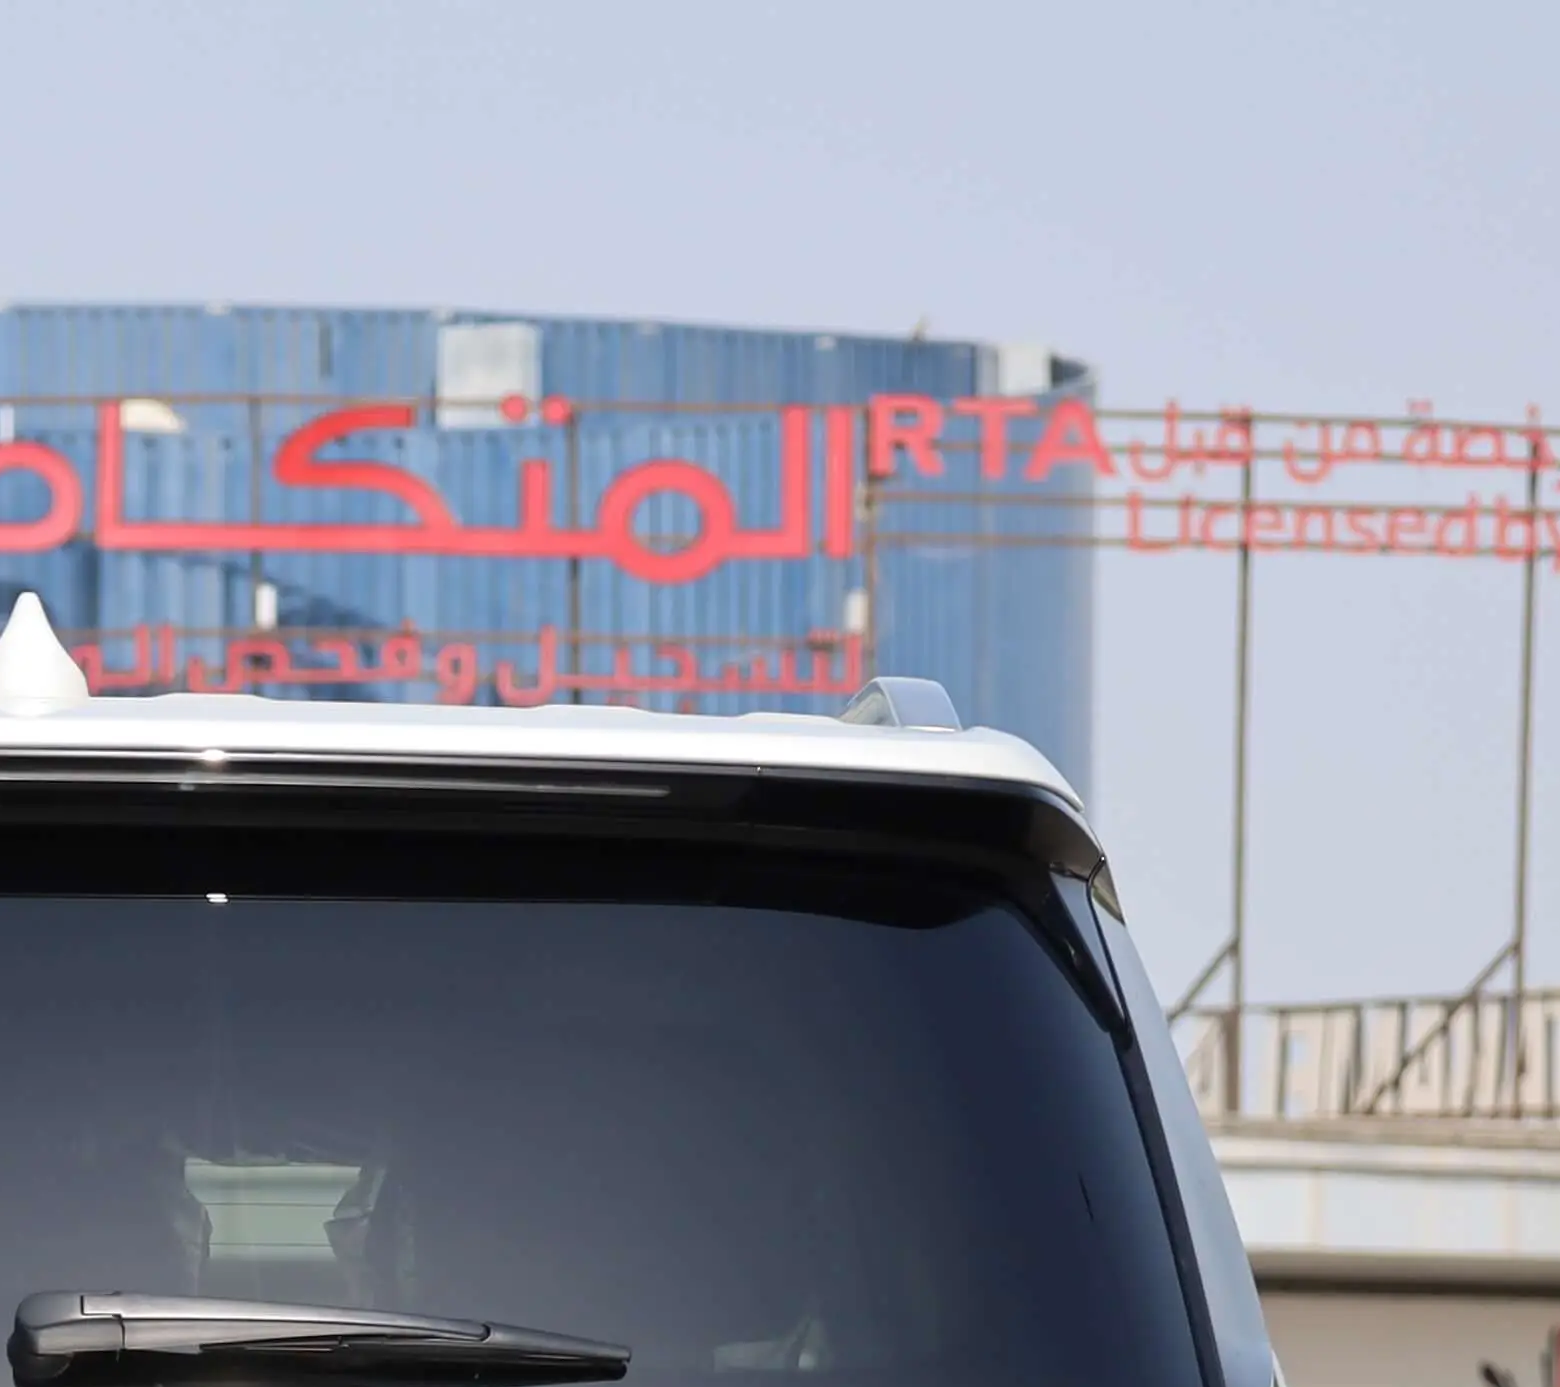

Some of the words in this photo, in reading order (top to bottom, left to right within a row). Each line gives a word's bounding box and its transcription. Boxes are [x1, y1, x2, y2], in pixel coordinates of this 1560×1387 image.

[869, 393, 1118, 481] RTA
[1128, 400, 1253, 480] قبل
[1283, 420, 1381, 482] من
[1126, 491, 1477, 555] Licensed
